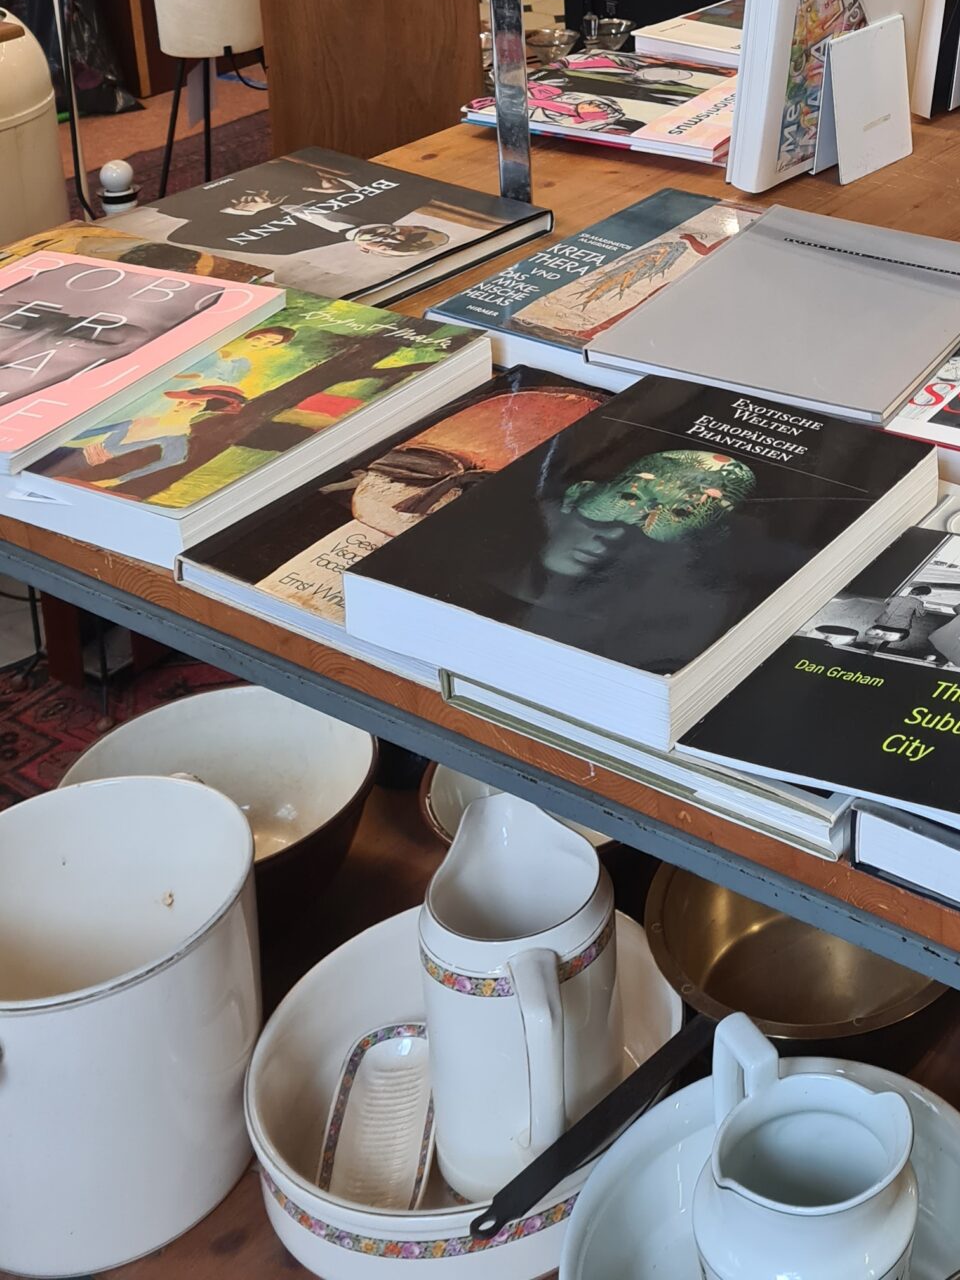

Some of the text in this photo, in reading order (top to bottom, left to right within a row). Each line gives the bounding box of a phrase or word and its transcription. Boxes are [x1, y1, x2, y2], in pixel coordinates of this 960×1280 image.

[226, 178, 400, 246] BECKMANN
[499, 269, 531, 282] DAS
[528, 252, 591, 276] THERA
[530, 267, 561, 281] VND
[18, 256, 255, 315] ROBO
[460, 288, 515, 308] HELLAS
[474, 282, 531, 302] NISCHE
[0, 296, 128, 340] ER
[731, 398, 824, 431] EXOTISCHE
[732, 409, 804, 437] WELTEN
[685, 424, 794, 463] PHANTASIEN
[693, 414, 808, 455] EUROPÄISCHE
[310, 553, 345, 574] Face
[278, 571, 315, 592] Ernst
[794, 659, 885, 688] Dan Graham
[881, 733, 935, 762] City
